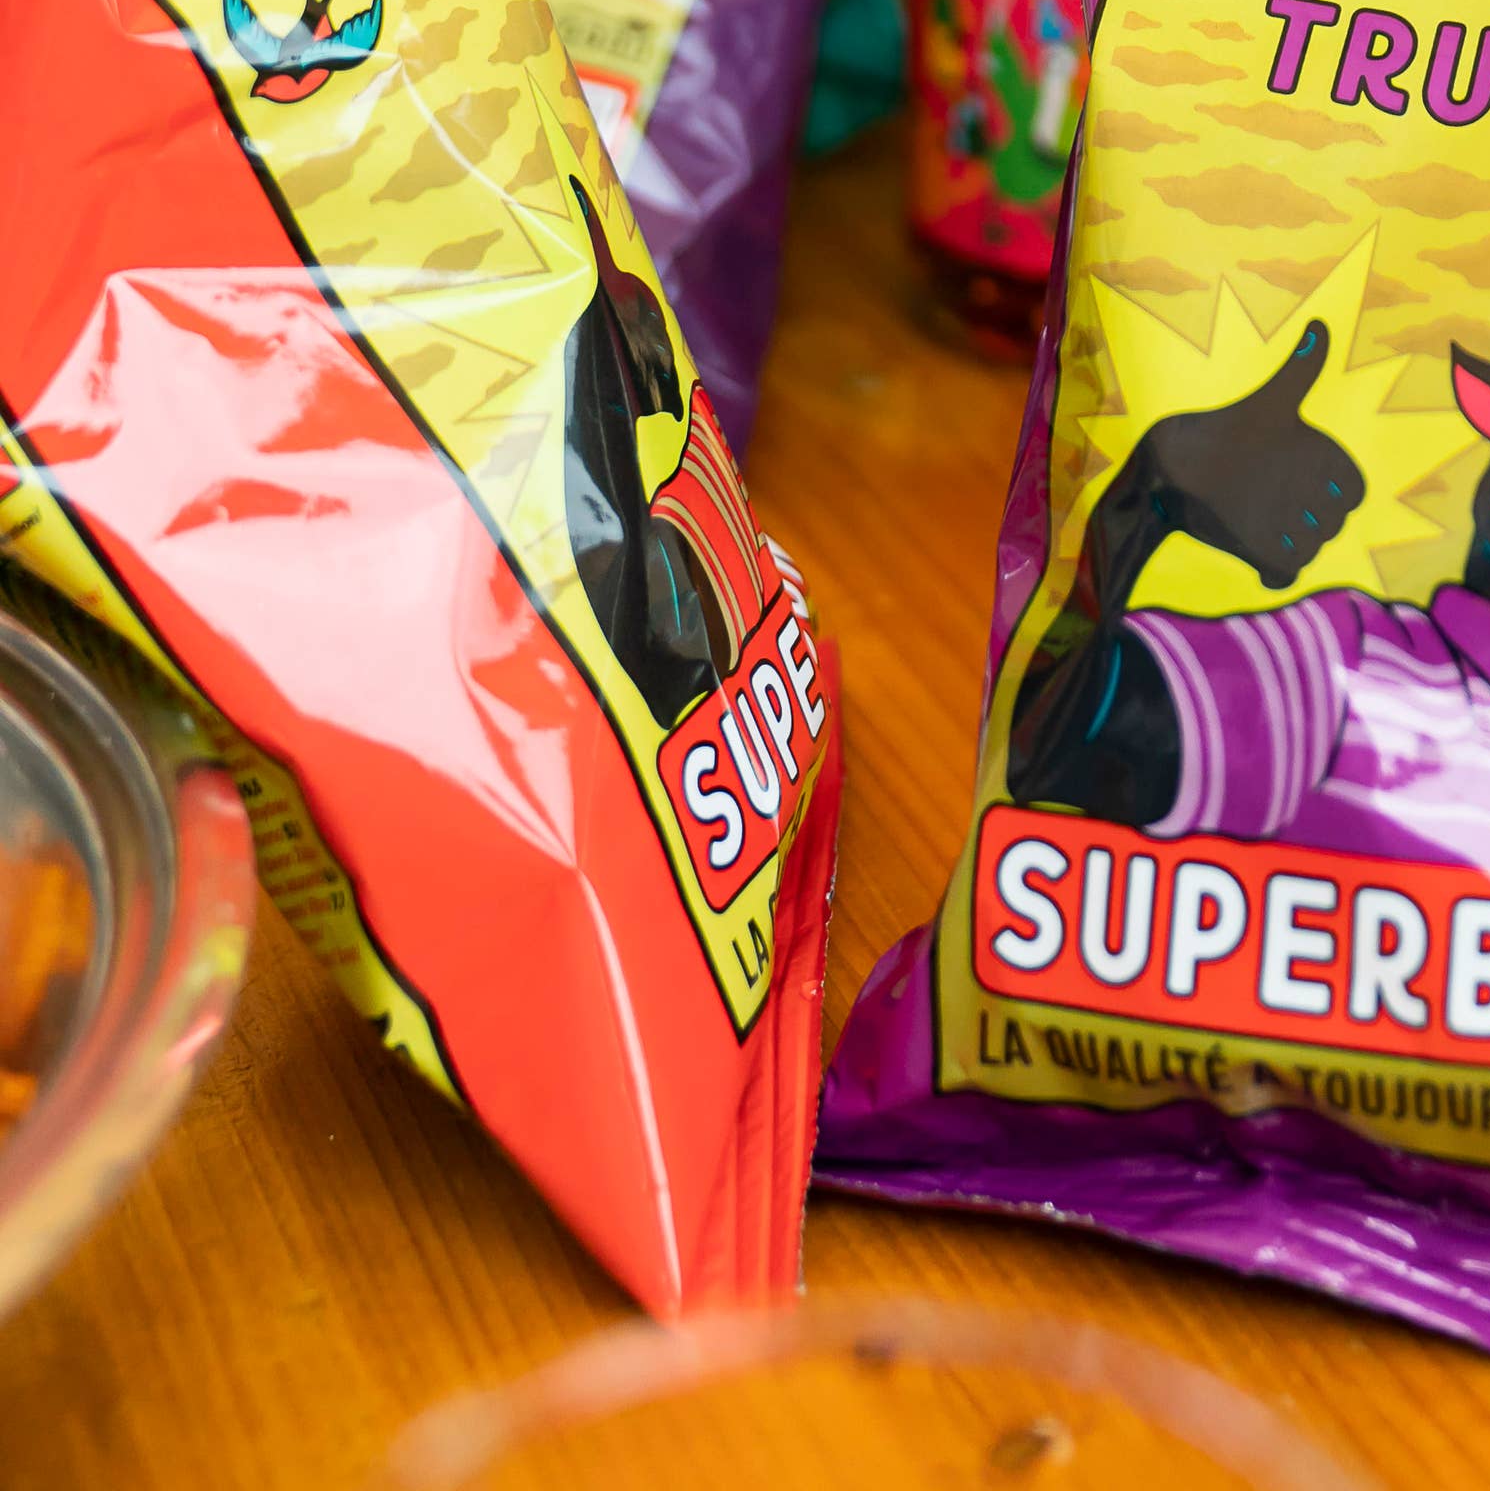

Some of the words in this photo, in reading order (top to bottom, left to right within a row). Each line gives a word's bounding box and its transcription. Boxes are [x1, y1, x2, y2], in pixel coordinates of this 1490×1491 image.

[731, 916, 770, 990] LA
[978, 1009, 1033, 1066] LA
[1044, 1024, 1234, 1093] QUALITÉ
